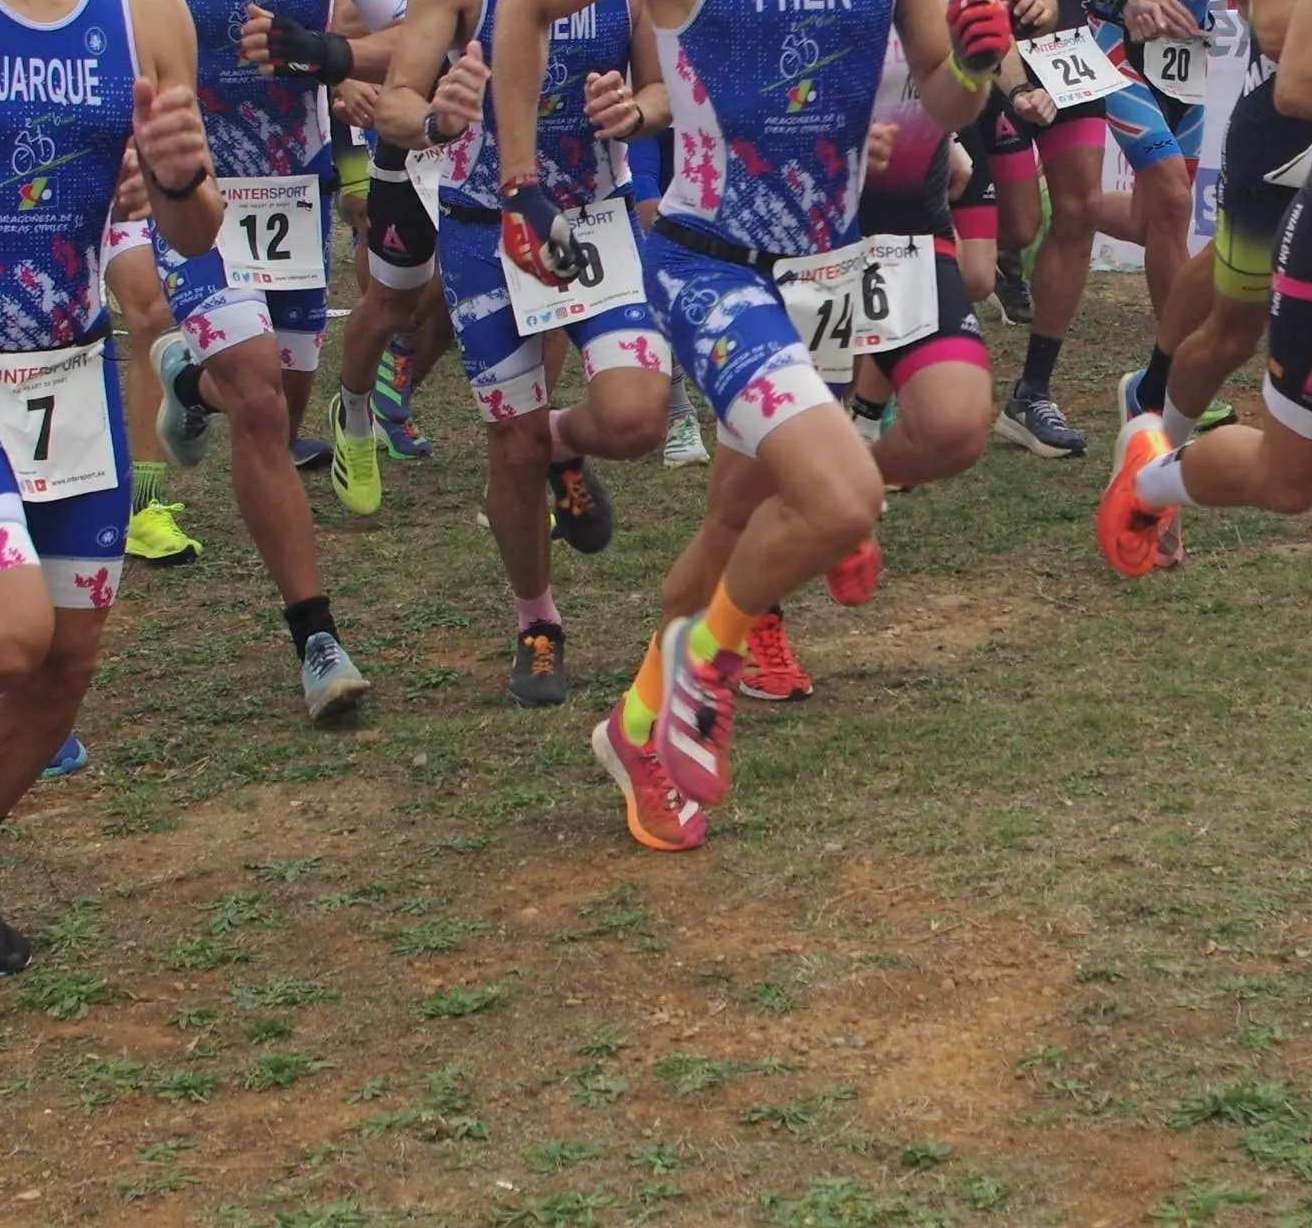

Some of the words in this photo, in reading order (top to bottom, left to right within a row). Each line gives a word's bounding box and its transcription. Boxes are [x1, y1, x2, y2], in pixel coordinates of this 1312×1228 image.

[549, 2, 597, 40] EMI
[1052, 55, 1097, 86] 24
[1161, 47, 1189, 82] 20
[228, 185, 308, 200] INTERSPORT
[240, 213, 292, 261] 12
[567, 211, 615, 230] SPORT
[868, 245, 921, 259] SPORT
[798, 256, 866, 284] INTERSPO
[809, 292, 854, 352] 14
[27, 394, 56, 461] 7
